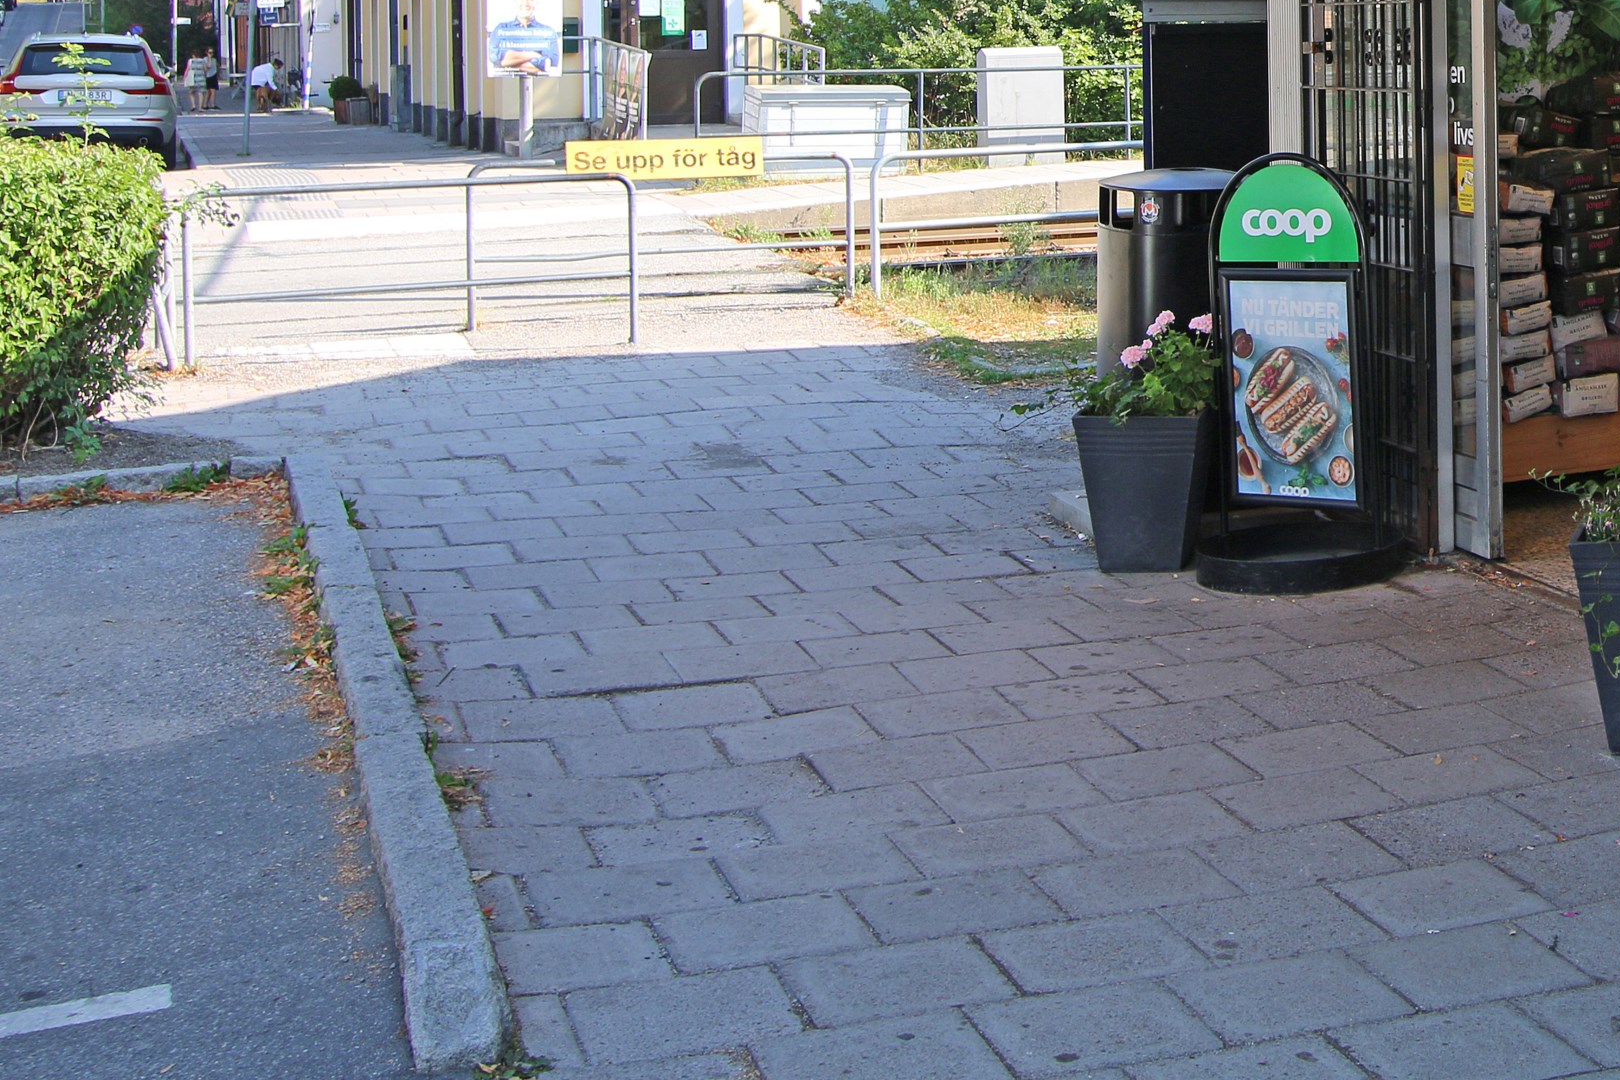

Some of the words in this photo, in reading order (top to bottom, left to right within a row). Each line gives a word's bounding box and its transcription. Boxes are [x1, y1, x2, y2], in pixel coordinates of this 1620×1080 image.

[574, 151, 607, 171] Se
[616, 154, 664, 173] upp
[672, 148, 708, 168] för
[717, 145, 756, 170] tåg
[1242, 208, 1332, 243] coop
[1242, 298, 1265, 316] NU
[1268, 297, 1339, 319] TÄNDER
[1244, 318, 1260, 335] VI
[1263, 319, 1339, 338] GRILLEN
